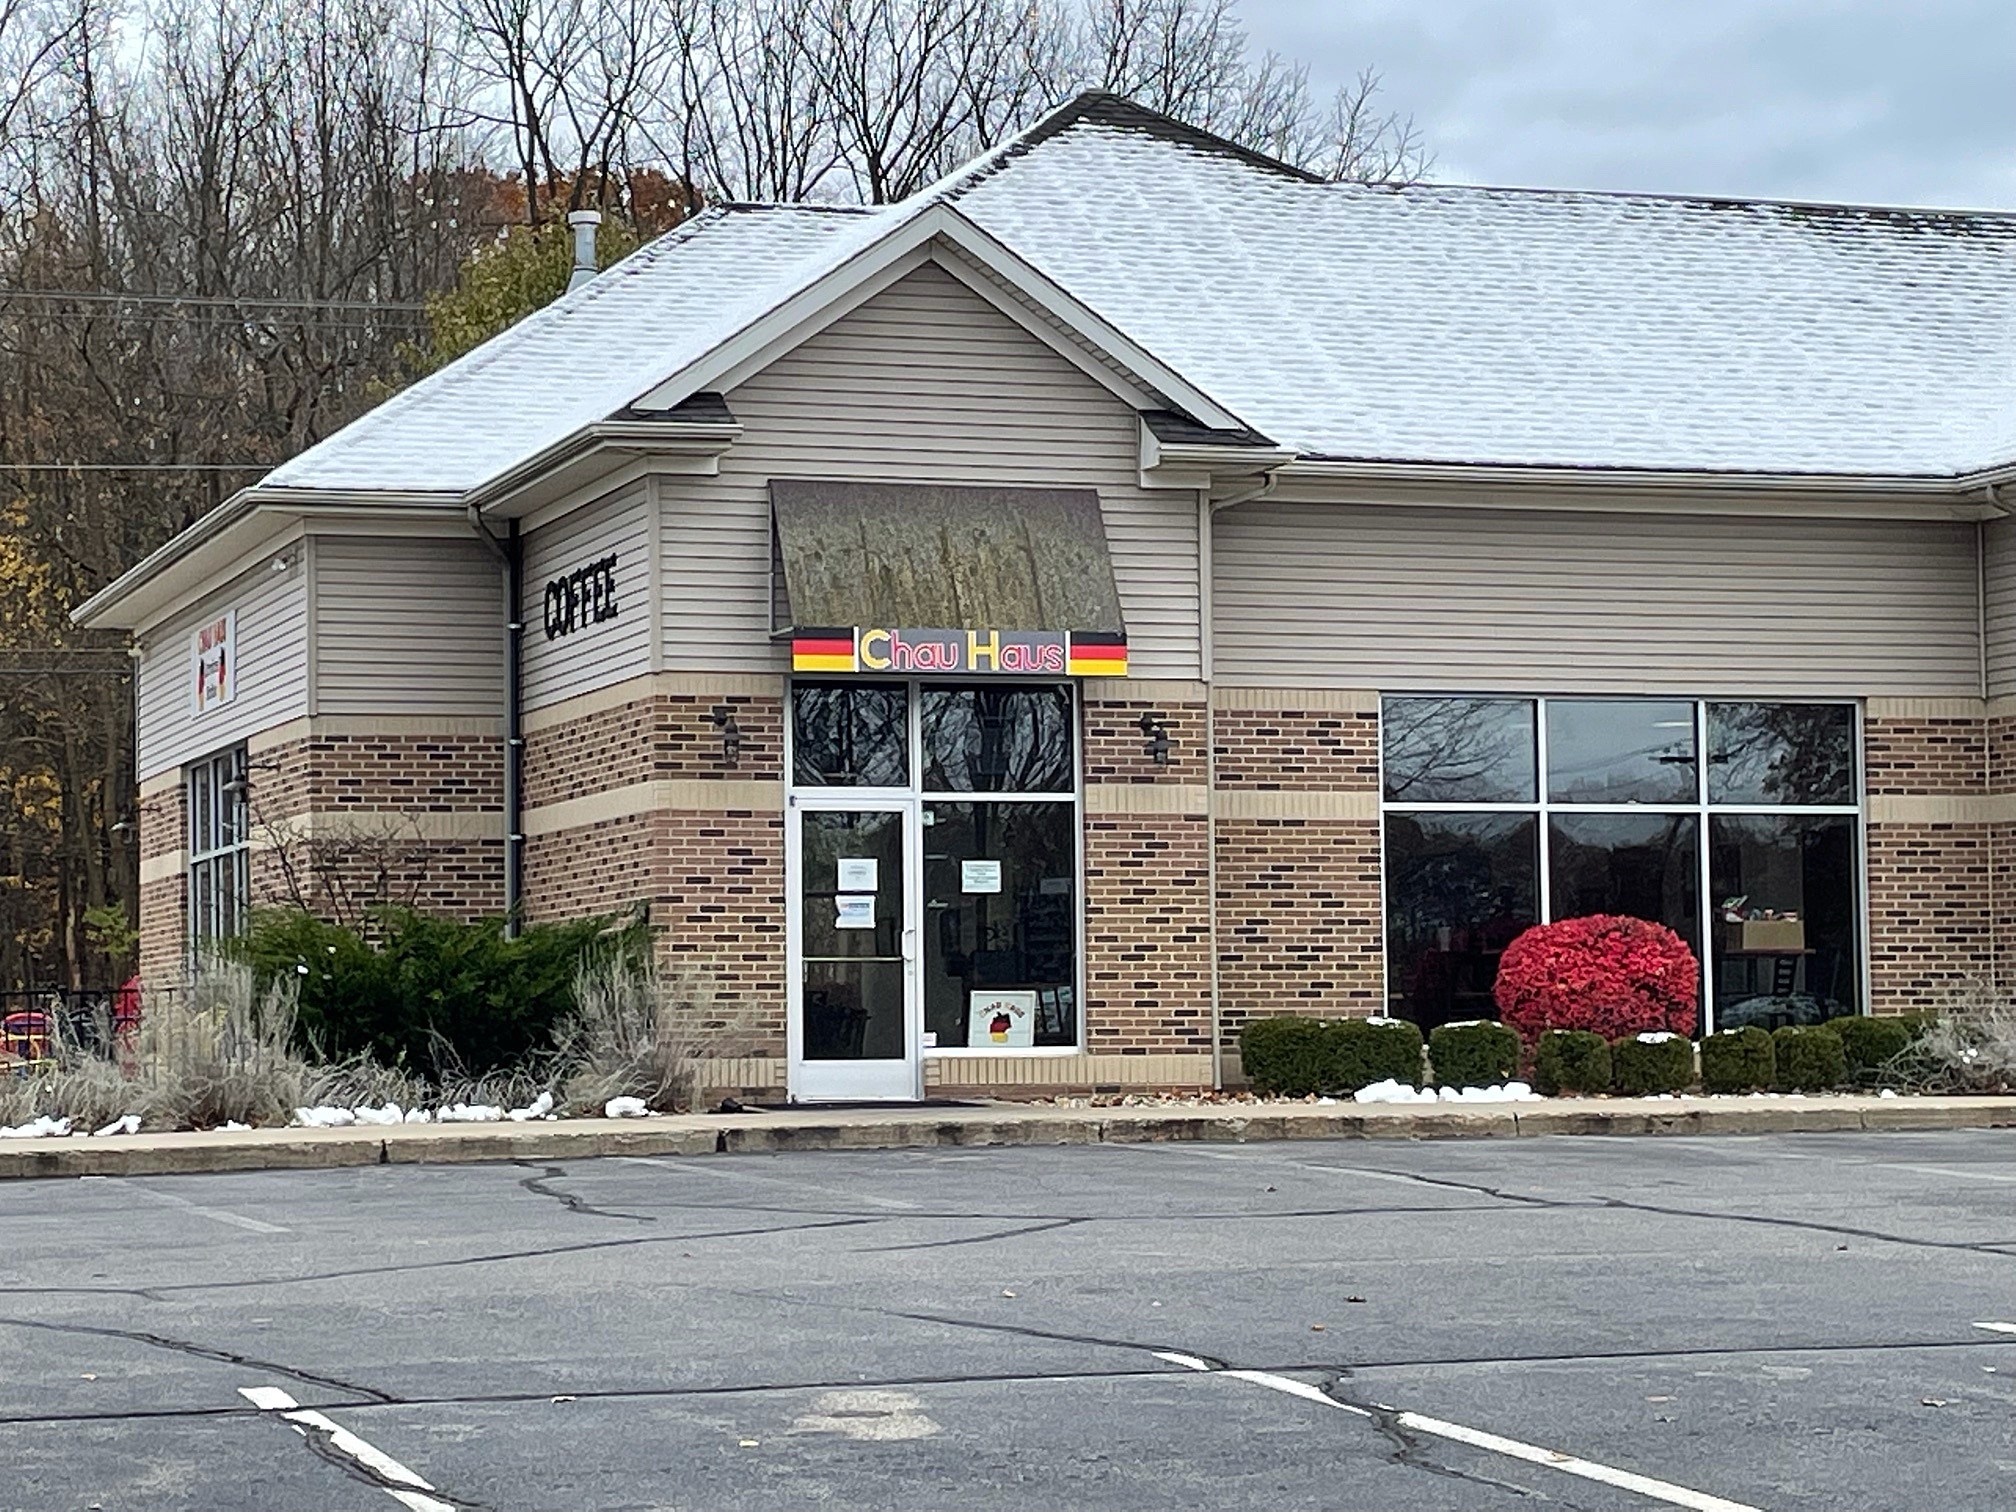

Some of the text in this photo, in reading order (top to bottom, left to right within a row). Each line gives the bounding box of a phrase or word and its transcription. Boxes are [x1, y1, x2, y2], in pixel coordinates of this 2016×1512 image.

[544, 553, 618, 641] COFFEE
[860, 629, 1064, 670] Chau Haus
